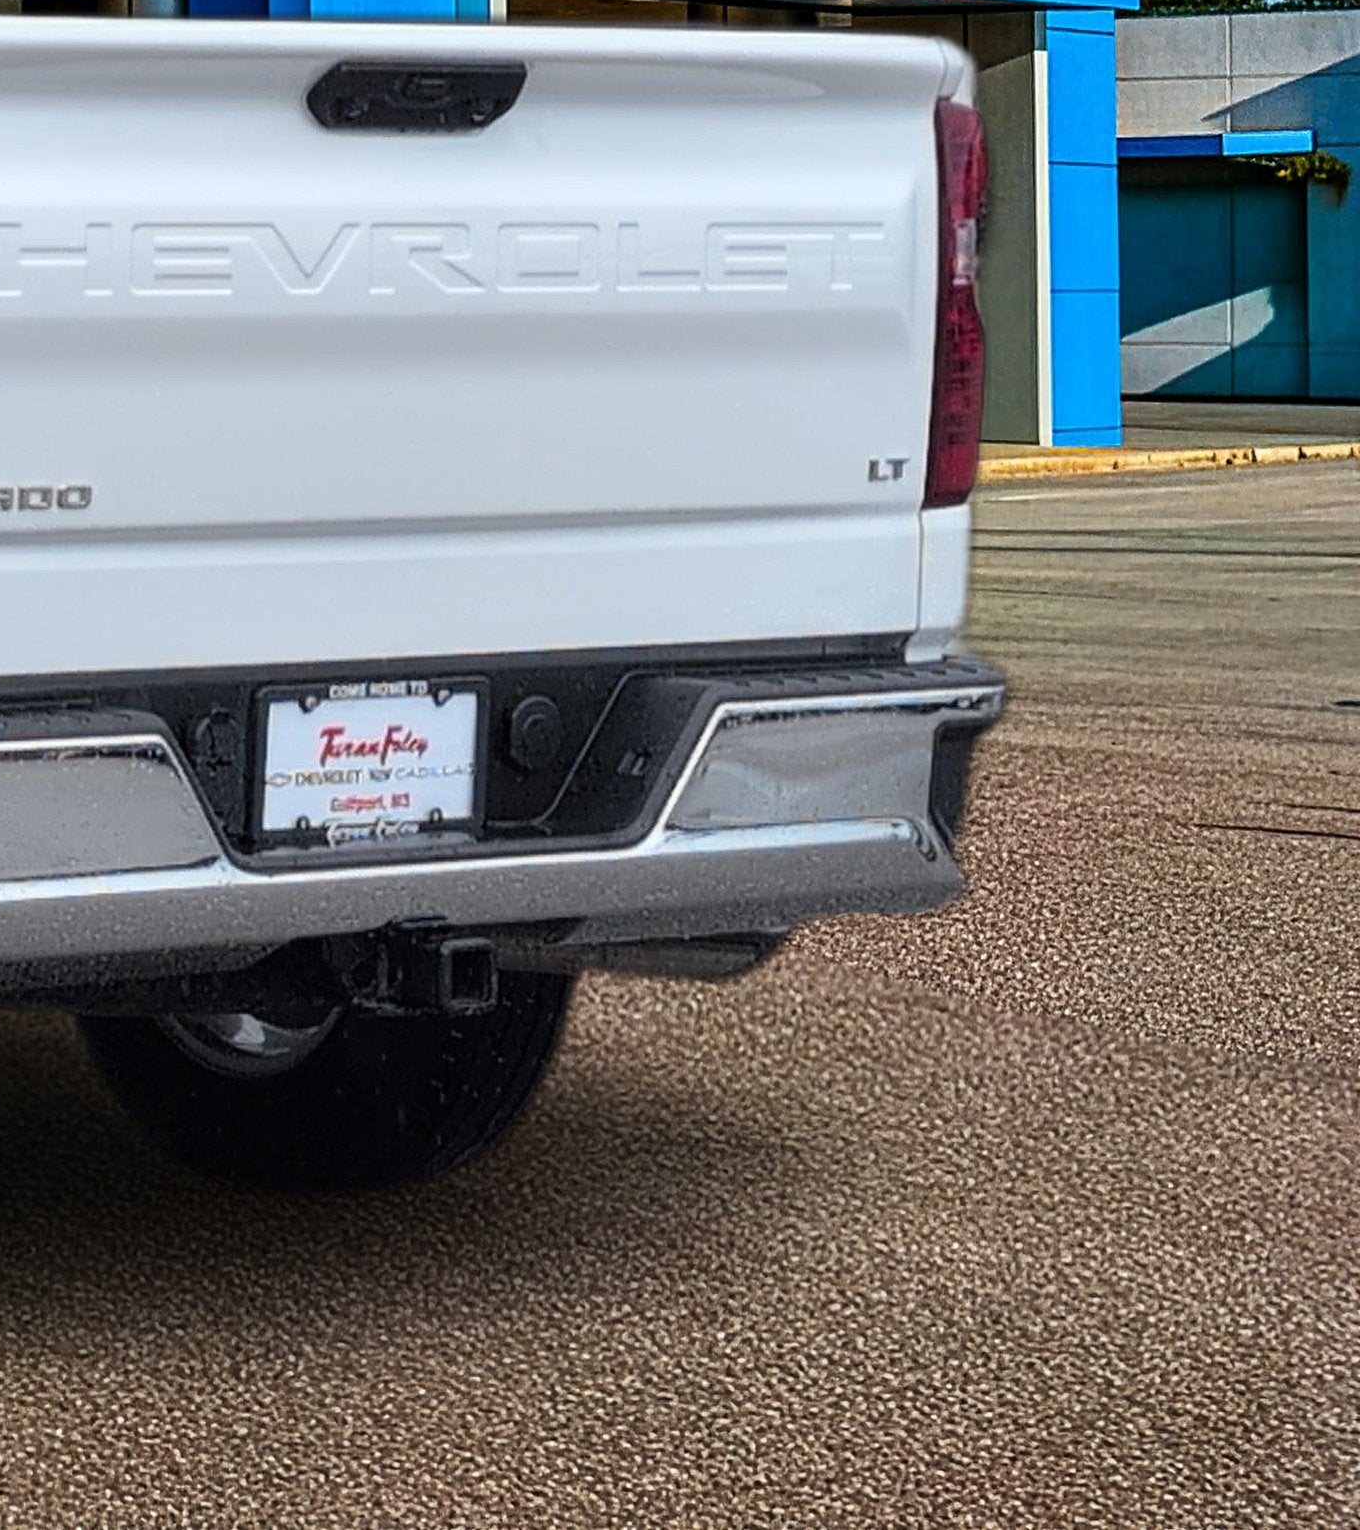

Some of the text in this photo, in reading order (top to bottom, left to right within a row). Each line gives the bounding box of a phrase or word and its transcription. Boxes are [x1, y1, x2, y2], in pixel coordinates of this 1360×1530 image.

[867, 457, 910, 483] LT
[318, 723, 429, 768] Turan Foley
